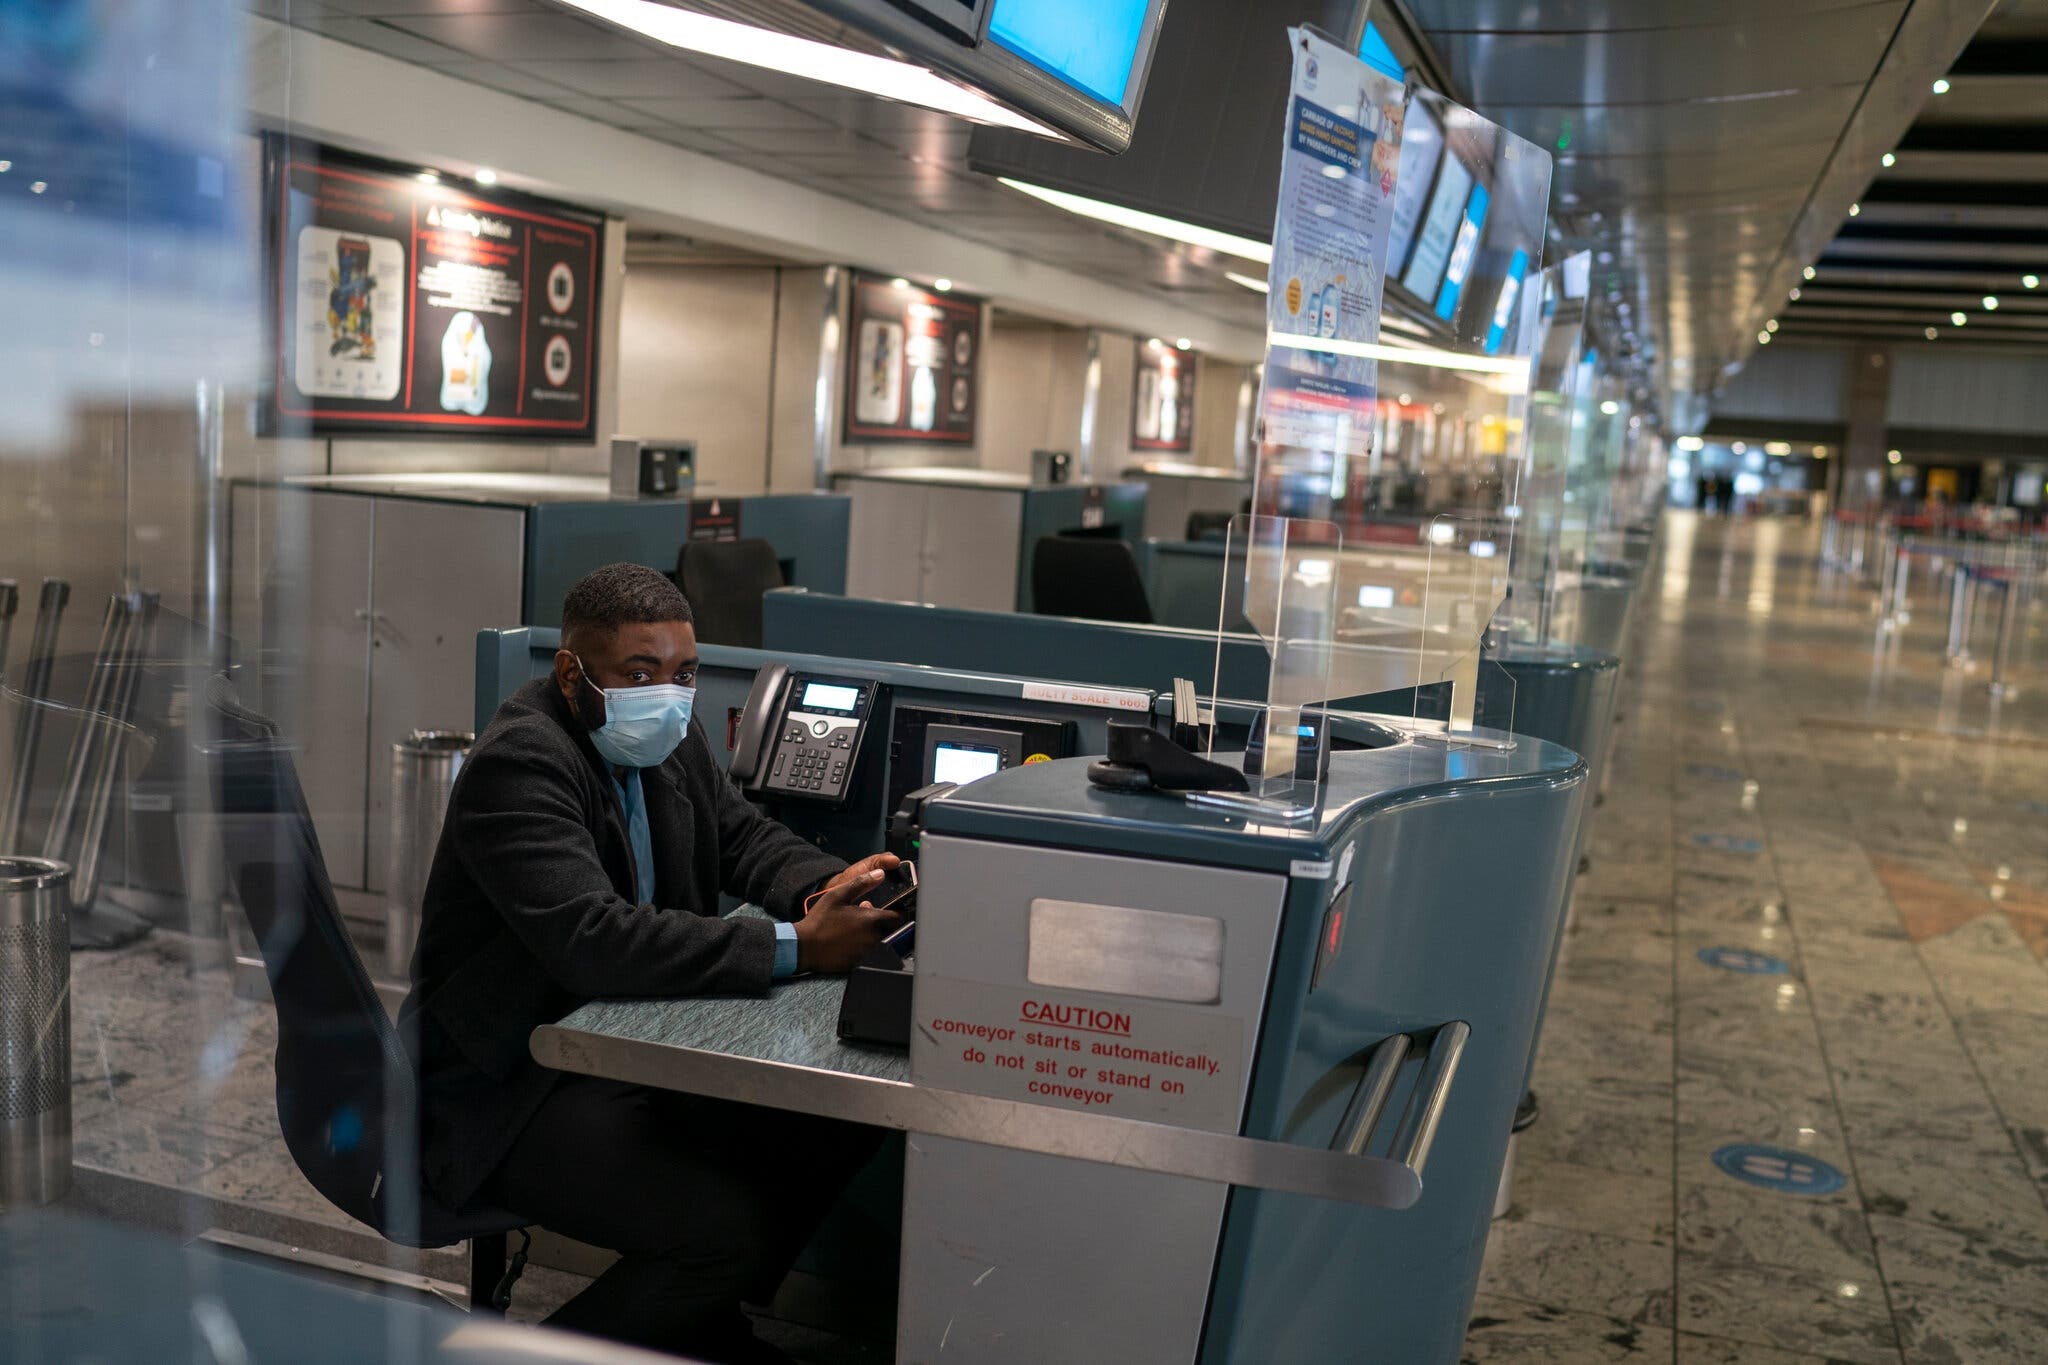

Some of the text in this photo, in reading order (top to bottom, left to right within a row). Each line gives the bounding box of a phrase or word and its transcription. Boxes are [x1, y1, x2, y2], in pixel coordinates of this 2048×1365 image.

[1071, 693, 1110, 705] SCALE
[1021, 1000, 1131, 1033] CAUTION
[931, 1018, 1221, 1074] conveyor starts automatically.
[963, 1048, 1185, 1095] do not sit or stand on
[1028, 1081, 1113, 1105] conveyor
